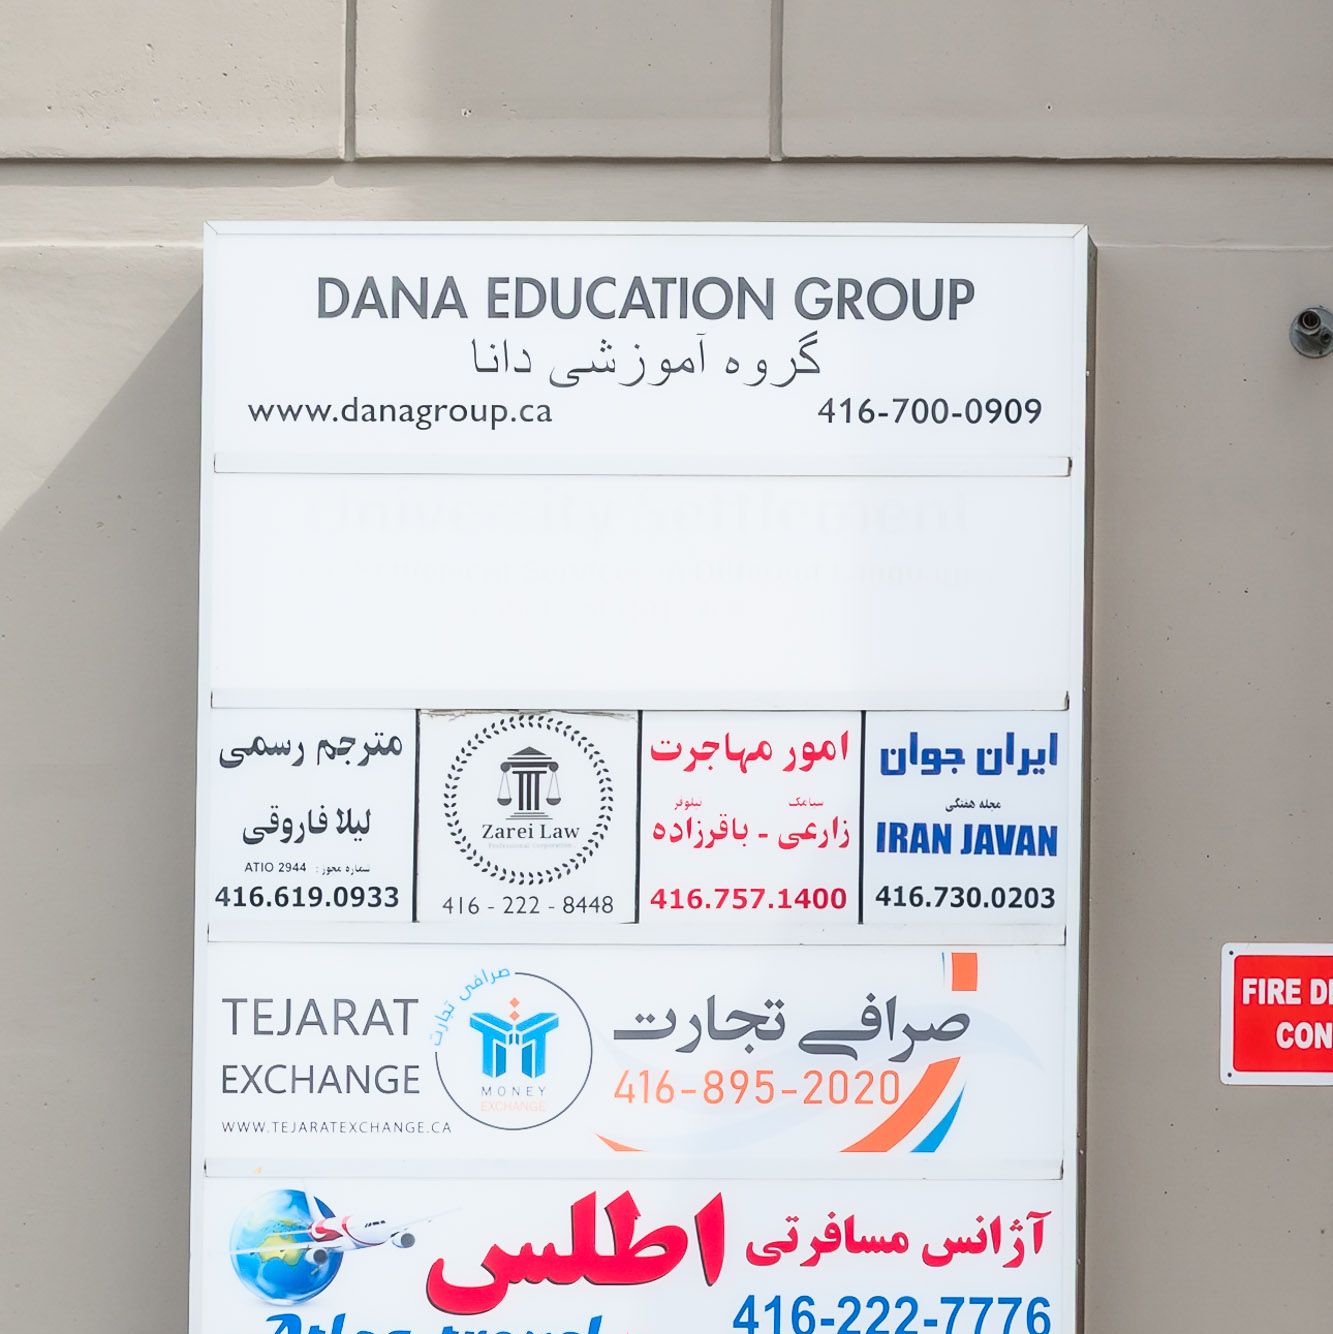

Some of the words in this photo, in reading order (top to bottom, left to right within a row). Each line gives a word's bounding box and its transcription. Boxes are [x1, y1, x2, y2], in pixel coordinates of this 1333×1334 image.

[318, 276, 468, 319] DANA
[488, 276, 774, 320] EDUCATION
[795, 277, 975, 321] GROUP
[471, 339, 531, 373] دانا
[549, 333, 705, 388] آموزشی
[725, 330, 820, 388] گروه
[248, 397, 552, 430] www.danagroup.ca
[818, 398, 1042, 424] 416-700-0909
[219, 736, 304, 769] رسمی
[317, 732, 402, 766] مترجم
[651, 732, 772, 774] مهاجرت
[782, 730, 848, 772] امور
[880, 732, 965, 776] جوان
[976, 732, 1058, 776] ایران
[243, 805, 328, 845] فاروقی
[336, 808, 371, 841] لیلا
[482, 823, 534, 839] Zarei
[540, 824, 580, 838] Law
[653, 813, 748, 849] باقرزاده
[778, 816, 850, 850] زارعی
[876, 822, 952, 855] IRAN
[960, 824, 1058, 857] JAVAN
[245, 862, 274, 872] ATIO
[279, 862, 306, 872] 2944
[215, 886, 399, 907] 416.619.0933
[442, 897, 479, 915] 416
[503, 896, 540, 914] 222
[563, 896, 613, 914] 8448
[650, 887, 847, 910] 416.757.1400
[875, 886, 1055, 909] 416.730.0203
[1242, 978, 1302, 1005] FIRE
[222, 998, 419, 1036] TEJARAT
[614, 995, 785, 1054] تجارت
[798, 991, 971, 1063] صرافی
[222, 1064, 420, 1094] EXCHANGE
[481, 1086, 546, 1097] MONEY
[614, 1069, 899, 1105] 416-895-2020
[480, 1101, 545, 1112] EXCHANGE
[222, 1122, 451, 1133] WWW.TEJARATEXCHANGE.CA
[426, 1189, 726, 1317] اطلس
[746, 1211, 909, 1267] مسافرتی
[922, 1211, 1052, 1268] آژانس
